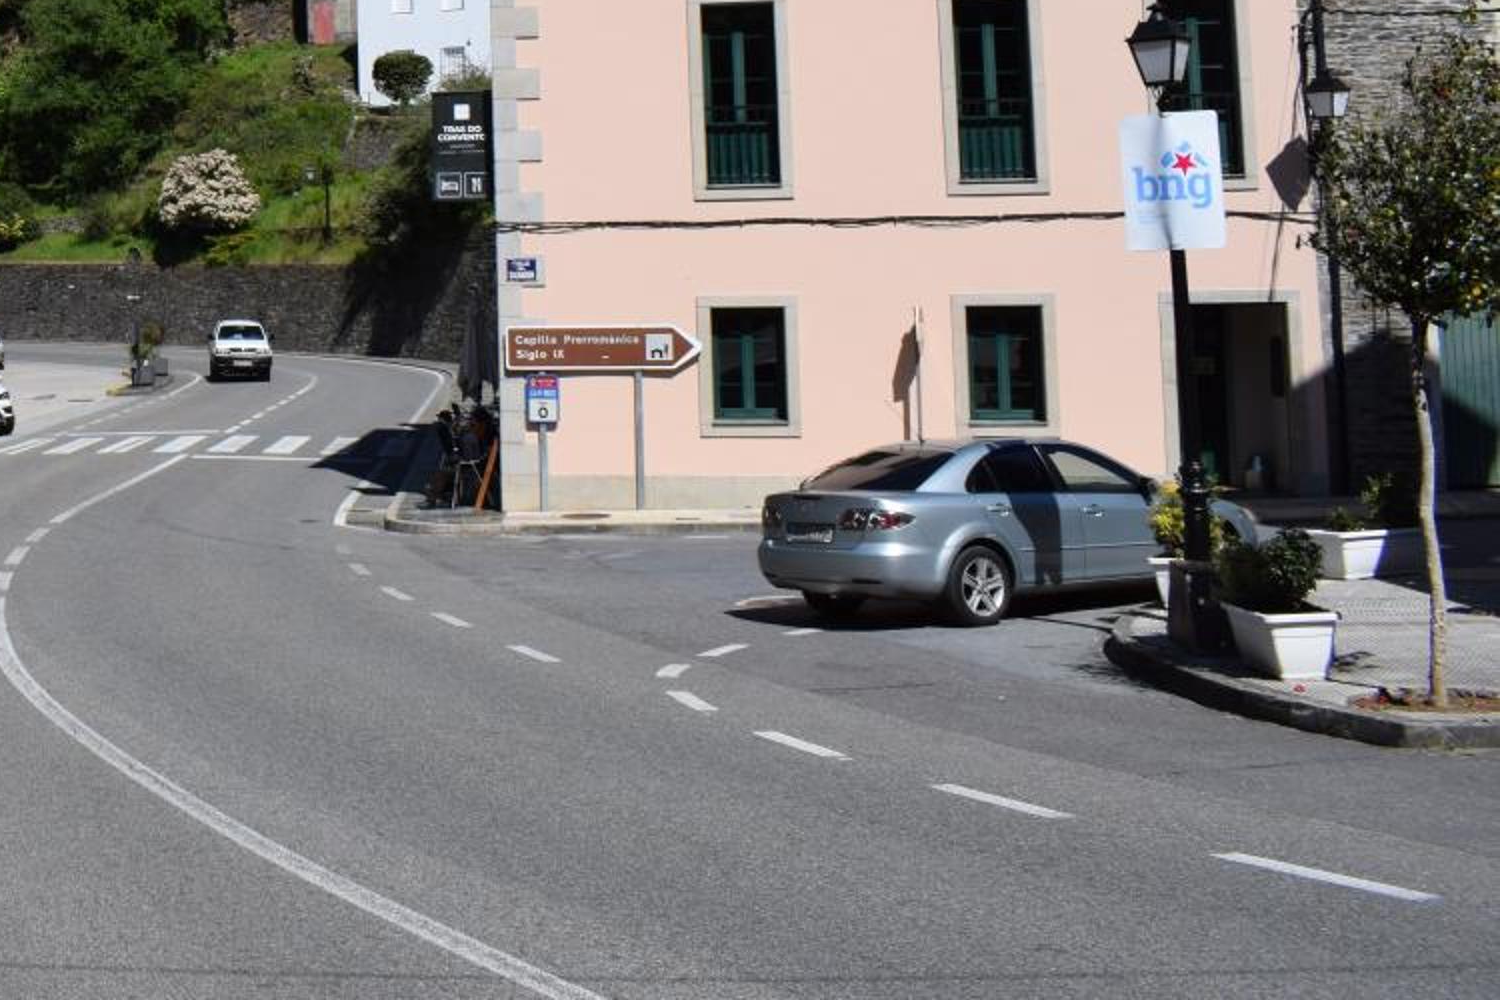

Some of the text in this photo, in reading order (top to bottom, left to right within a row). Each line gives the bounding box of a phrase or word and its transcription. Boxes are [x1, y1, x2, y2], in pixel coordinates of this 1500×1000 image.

[1131, 166, 1213, 209] bng
[515, 334, 557, 346] Capilla
[516, 349, 565, 361] Siglo IX
